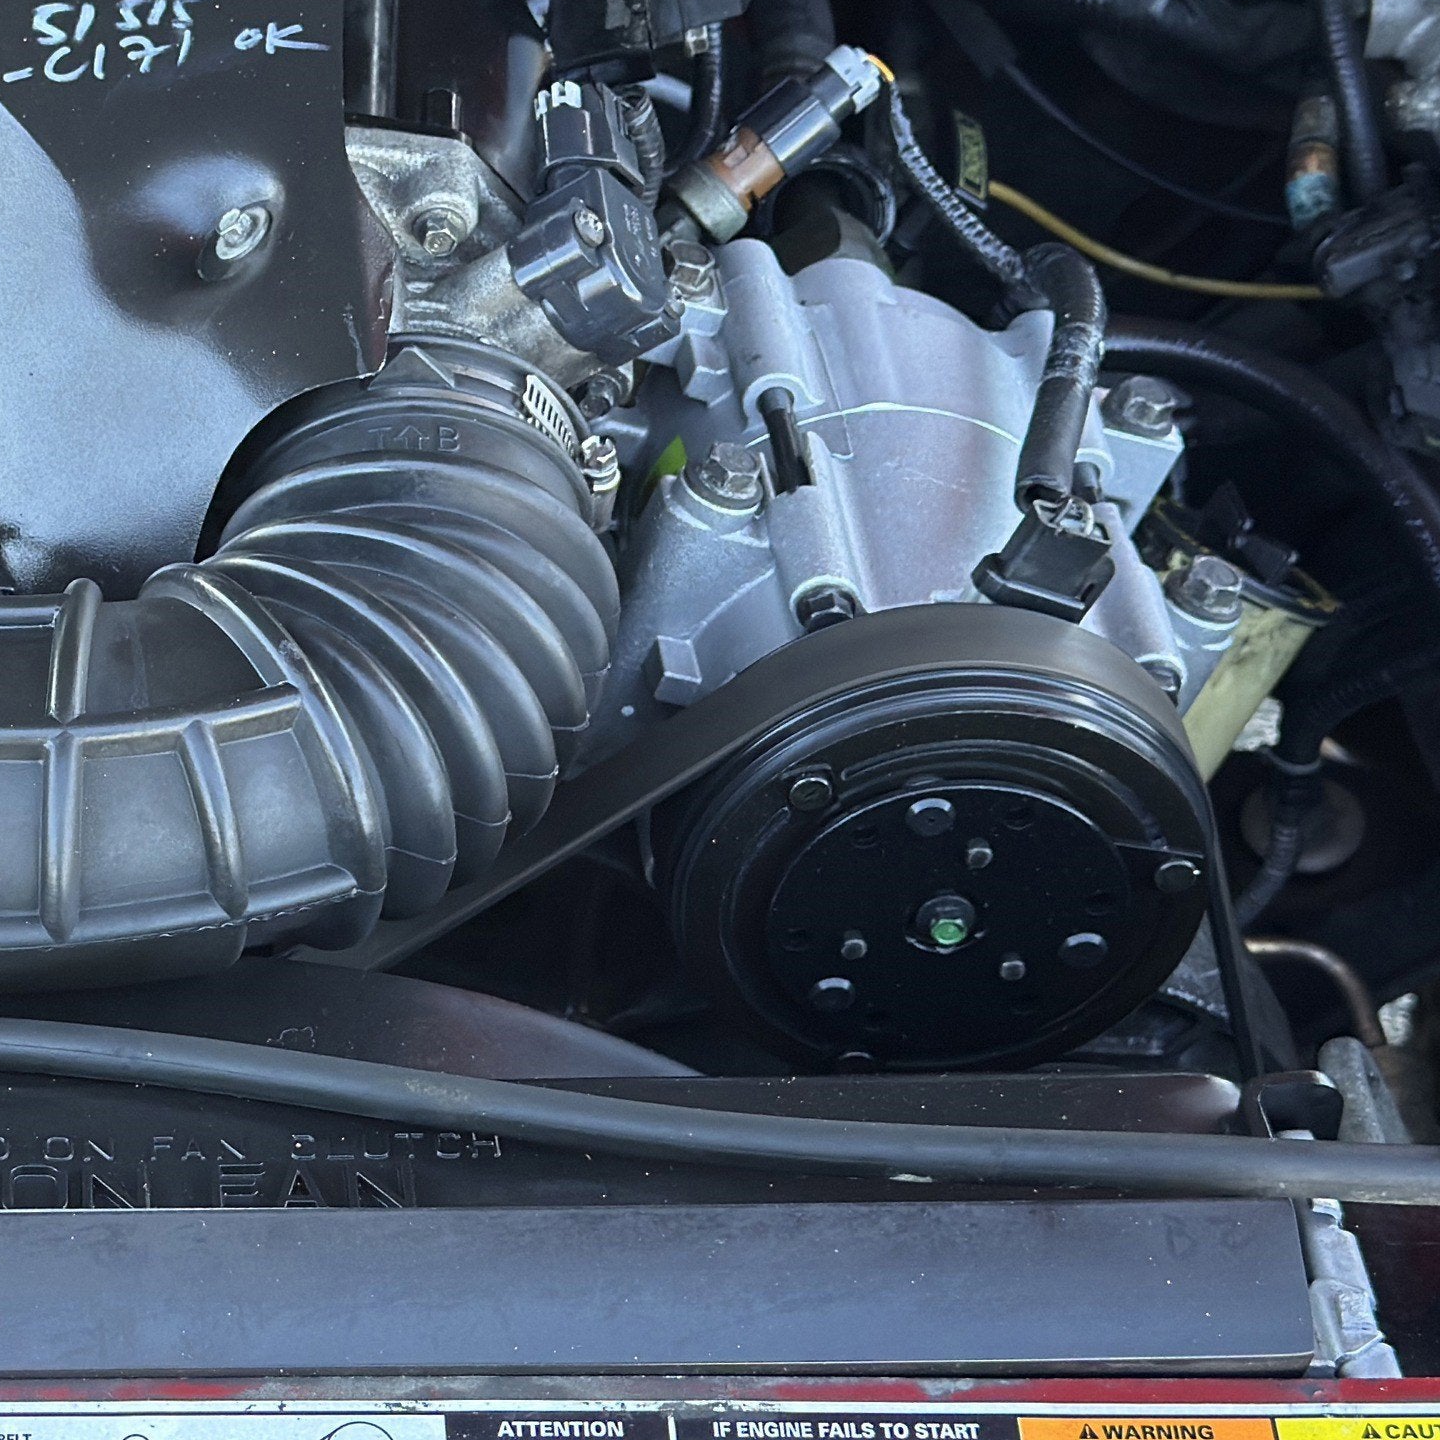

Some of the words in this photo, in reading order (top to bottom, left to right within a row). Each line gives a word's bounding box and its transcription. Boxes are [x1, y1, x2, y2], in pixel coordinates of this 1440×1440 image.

[151, 1134, 247, 1160] FAN
[291, 1131, 501, 1160] CLUTCH
[219, 1161, 417, 1209] FAN
[497, 1420, 624, 1437] ATTENTION
[712, 1421, 730, 1437] IF
[736, 1421, 813, 1437] ENGINE
[817, 1422, 875, 1438] FAILS
[878, 1422, 908, 1439] TO
[914, 1422, 979, 1439] START
[1101, 1424, 1214, 1439] WARNING
